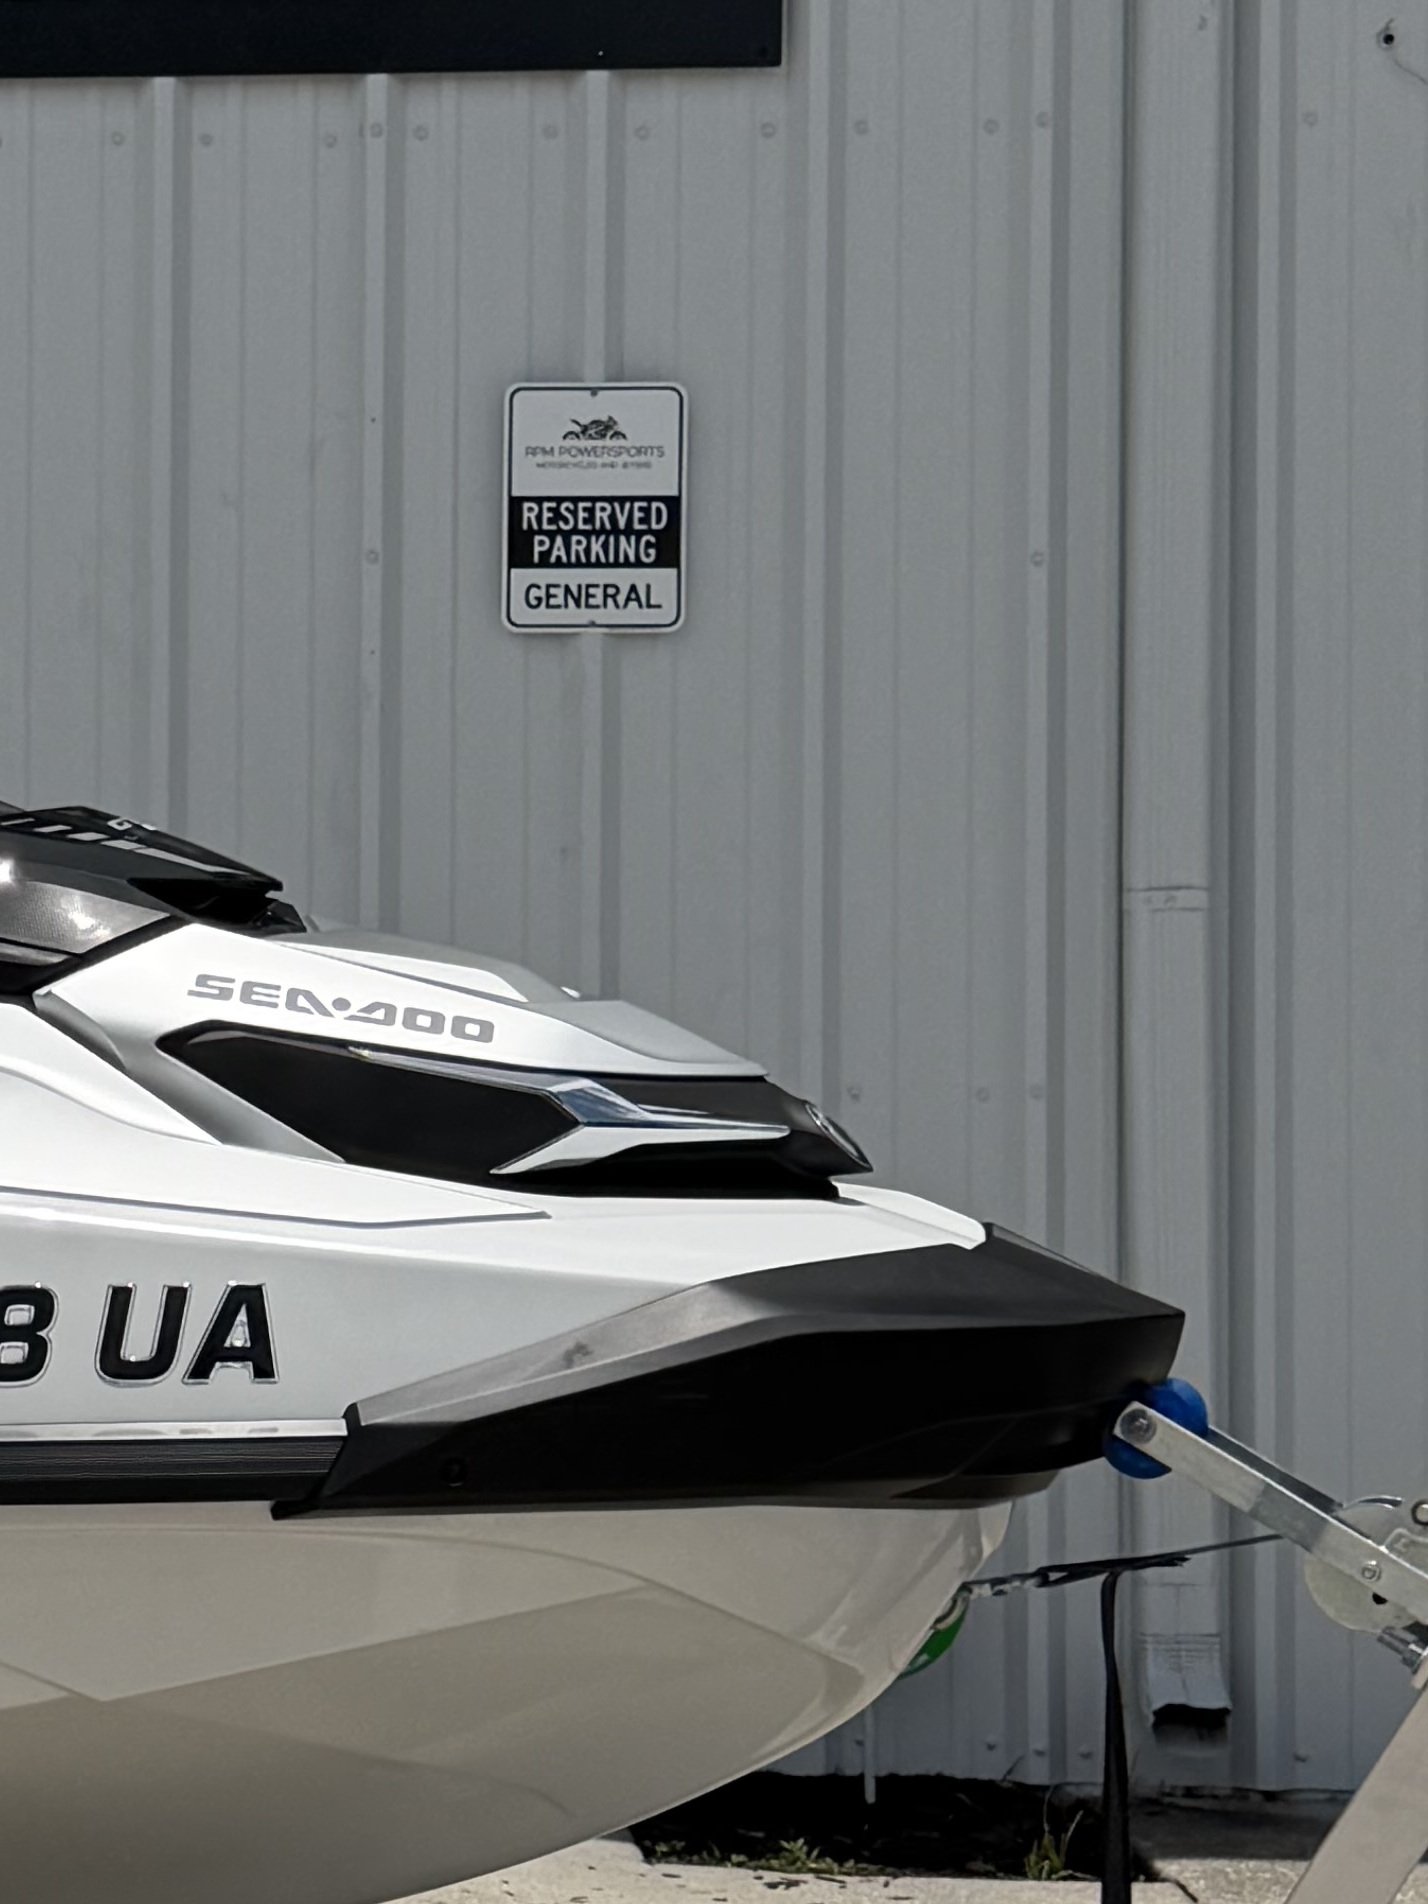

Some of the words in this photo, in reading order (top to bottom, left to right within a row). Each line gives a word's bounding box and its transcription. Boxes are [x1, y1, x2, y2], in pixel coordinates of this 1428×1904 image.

[558, 445, 665, 458] POWERSPORTS
[522, 501, 668, 530] RESERVED
[533, 534, 657, 564] PARKING
[524, 583, 663, 609] GENERAL
[94, 1282, 280, 1385] UA
